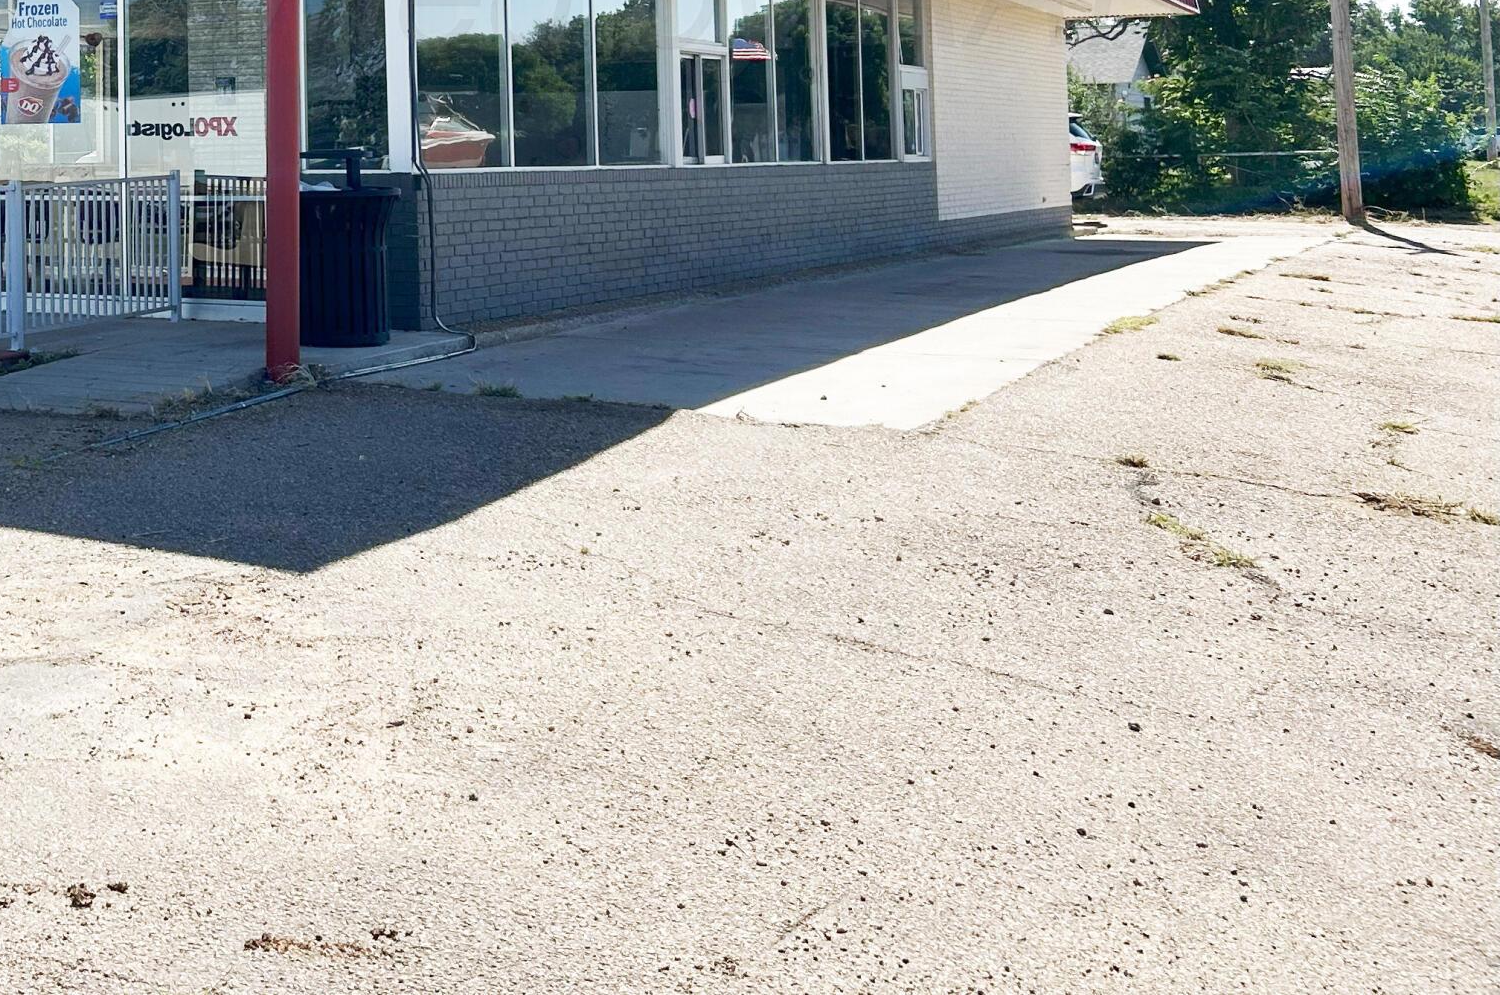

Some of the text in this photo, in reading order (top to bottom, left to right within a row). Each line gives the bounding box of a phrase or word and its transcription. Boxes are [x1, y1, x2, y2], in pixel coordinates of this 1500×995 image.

[19, 2, 59, 17] Frozen
[11, 17, 68, 29] Hot Chocolate
[20, 99, 40, 114] DQ
